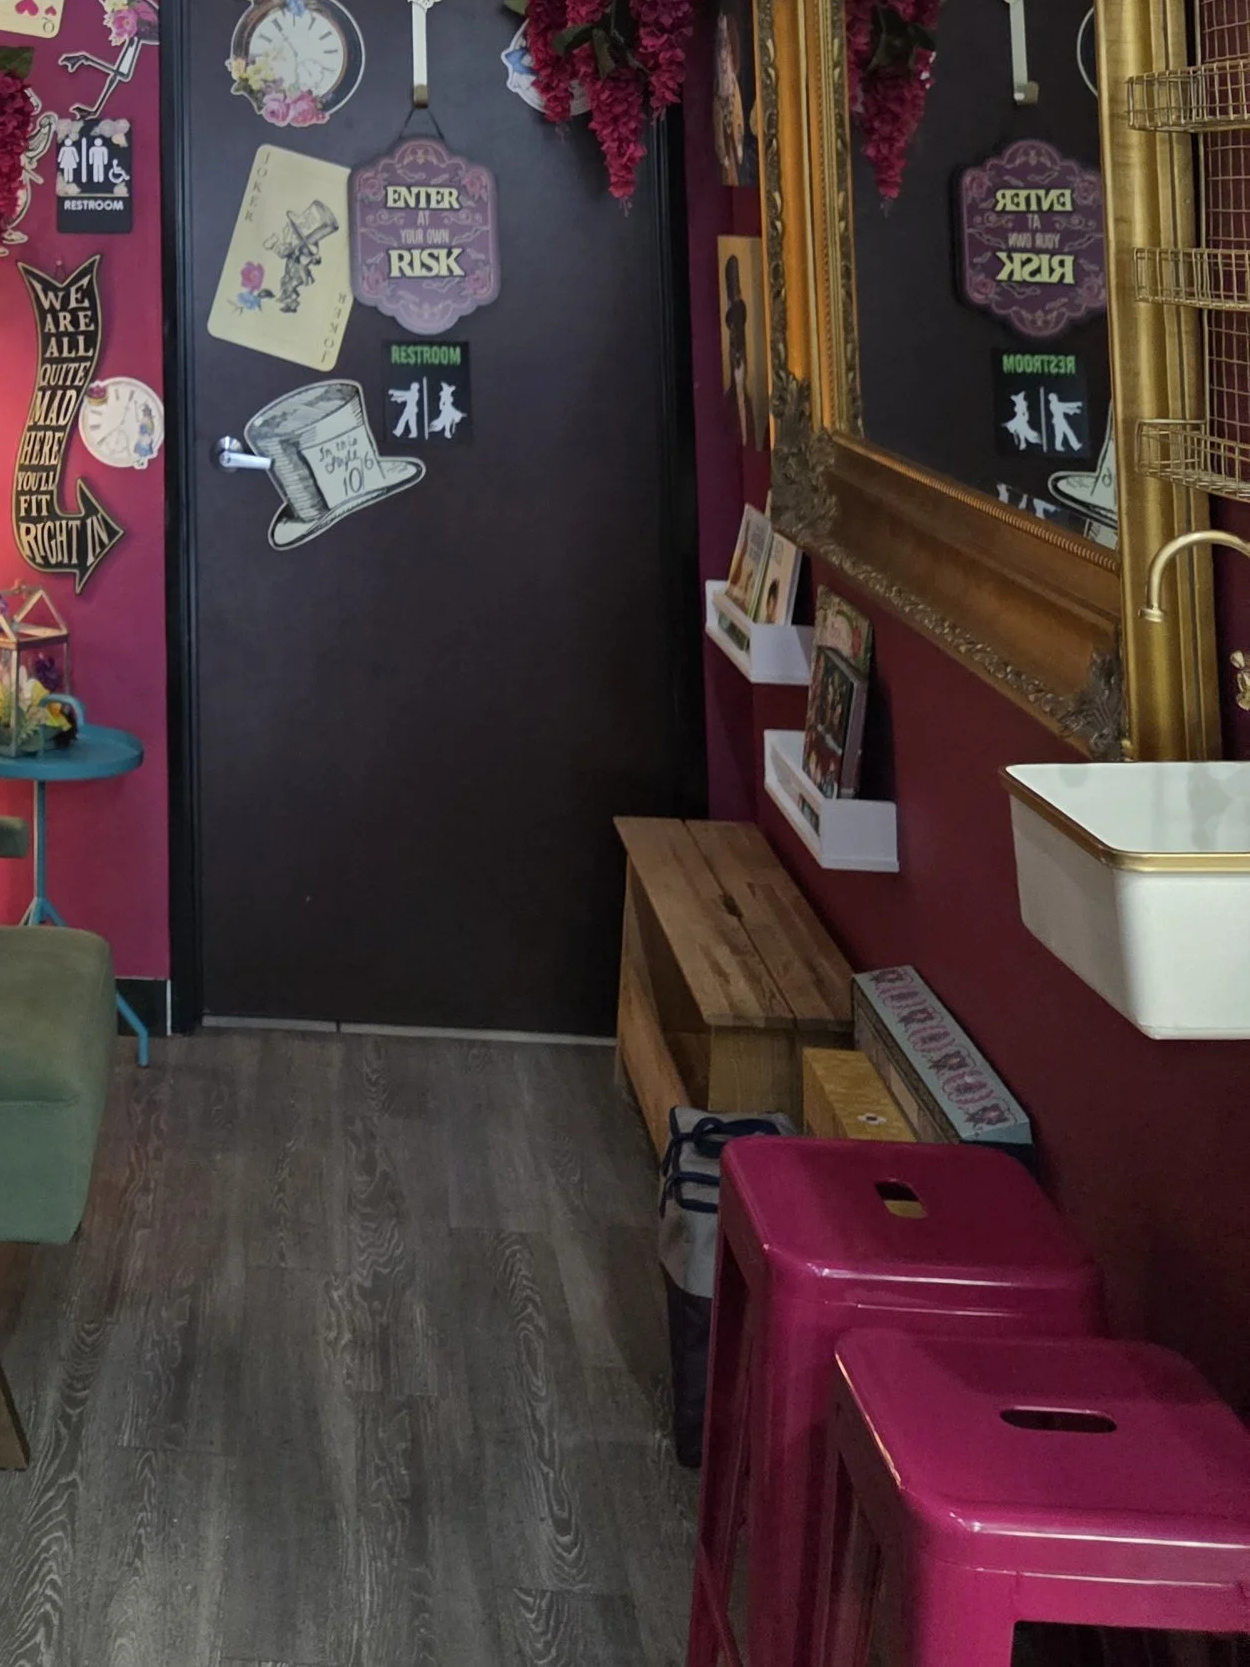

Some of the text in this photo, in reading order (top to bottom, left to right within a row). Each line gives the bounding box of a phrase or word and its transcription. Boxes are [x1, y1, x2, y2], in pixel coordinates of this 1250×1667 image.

[245, 152, 270, 222] JOKER
[386, 186, 460, 209] ENTER
[64, 199, 124, 211] RESTROOM
[417, 210, 430, 226] AT
[401, 229, 450, 244] YOUR OWN
[388, 248, 466, 277] RISK
[28, 274, 92, 310] WE
[44, 310, 95, 333] ARE
[44, 335, 94, 358] ALL
[391, 345, 461, 365] RESTROOM
[40, 361, 92, 387] QUITE
[29, 389, 78, 426] MAD
[21, 431, 63, 466] HERE
[17, 471, 56, 491] YOU'LL
[19, 495, 51, 517] FIT
[19, 513, 110, 566] RIGHT IN
